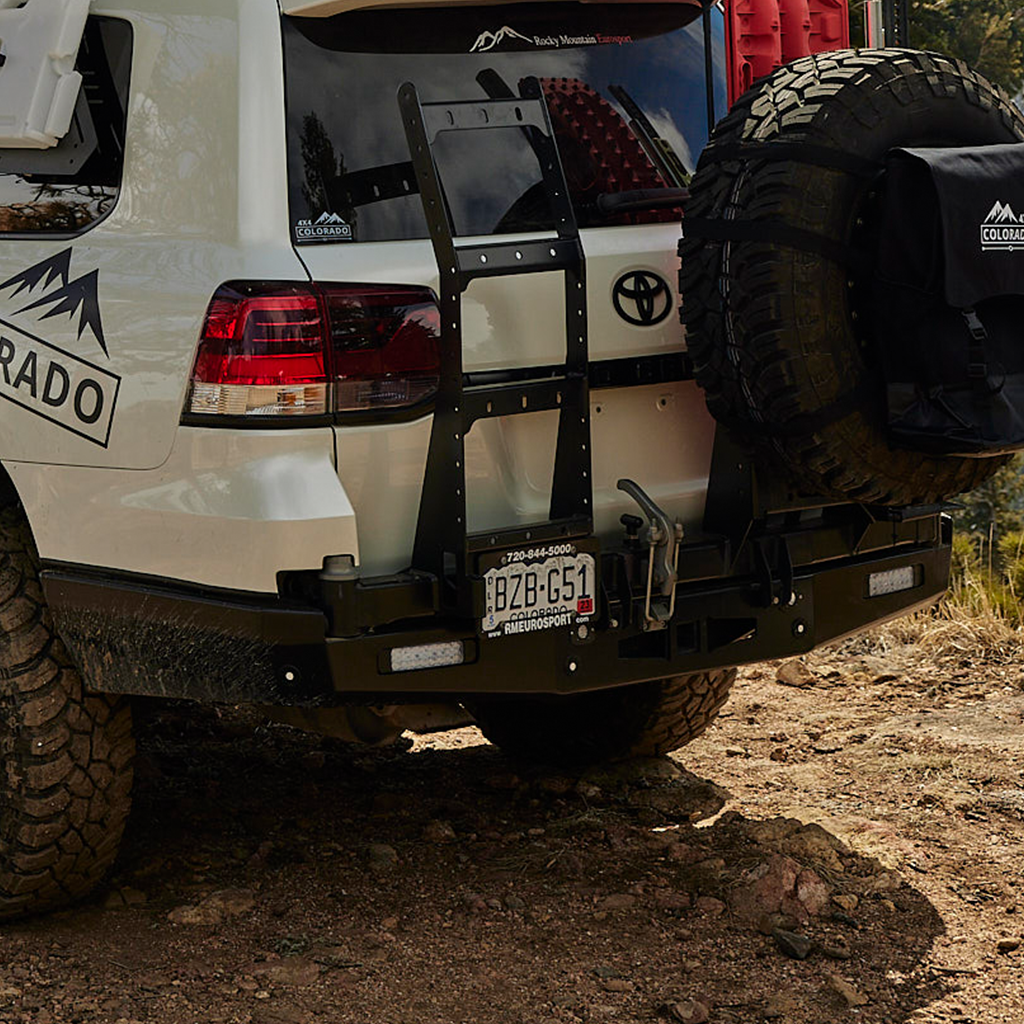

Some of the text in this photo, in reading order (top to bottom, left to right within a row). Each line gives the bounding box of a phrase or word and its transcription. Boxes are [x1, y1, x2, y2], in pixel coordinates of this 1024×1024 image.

[533, 35, 559, 47] Rocky
[559, 33, 597, 45] Mountain
[298, 227, 349, 236] COLORADO
[507, 543, 572, 563] 720-844-5000
[505, 613, 571, 635] RMEUROSPORT
